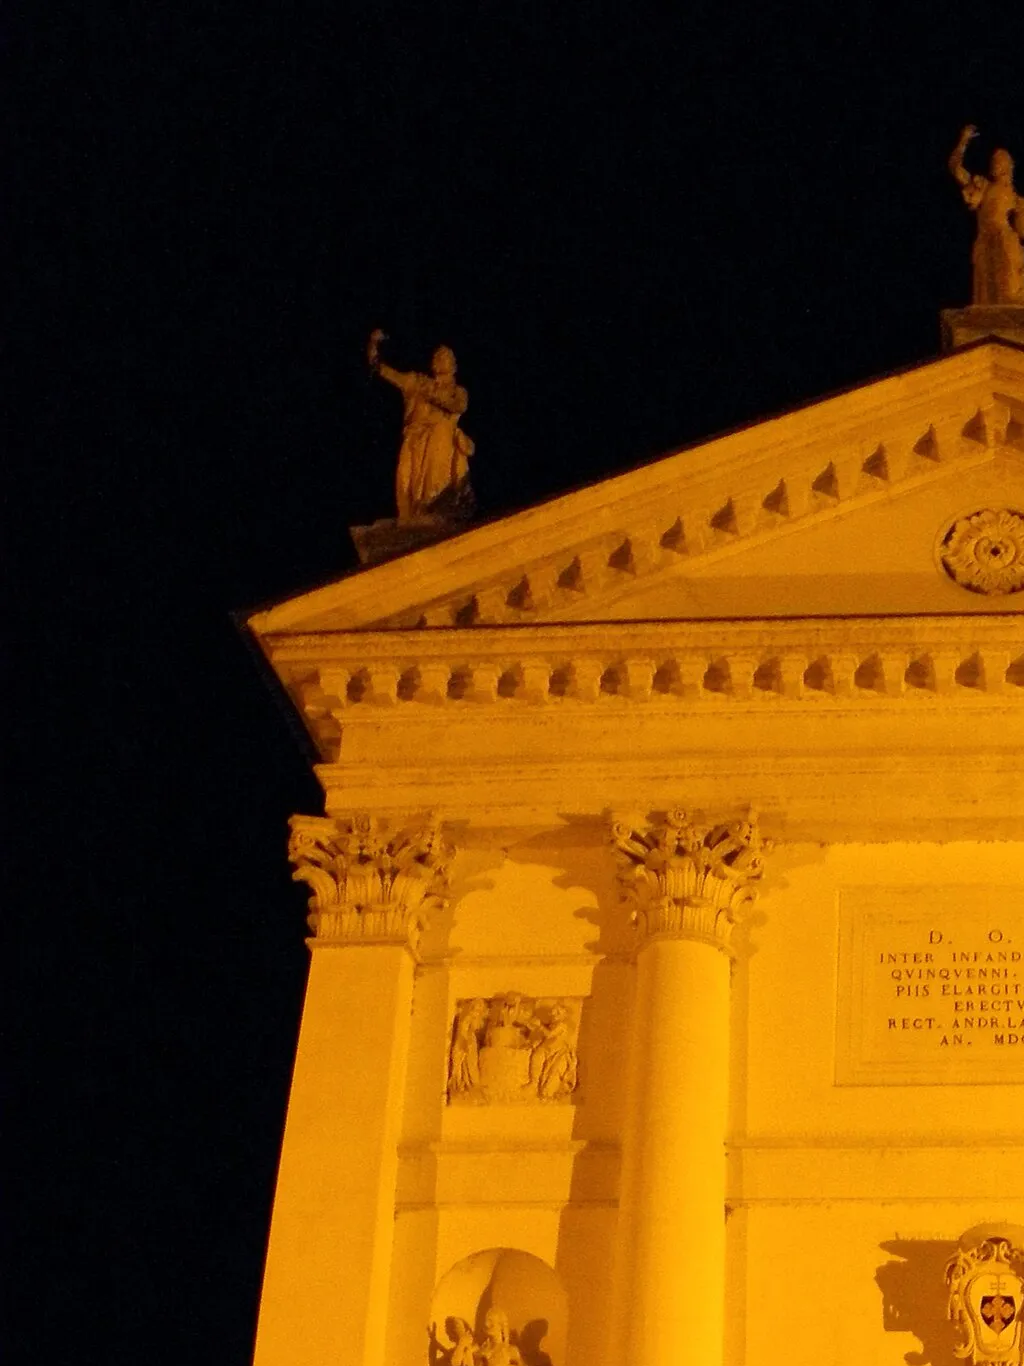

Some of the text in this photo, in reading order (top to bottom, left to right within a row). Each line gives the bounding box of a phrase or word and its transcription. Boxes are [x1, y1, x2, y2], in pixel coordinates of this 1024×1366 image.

[928, 928, 953, 945] D.
[987, 928, 1013, 944] O.
[879, 952, 935, 965] INTER
[887, 1016, 944, 1030] RECT.
[938, 1033, 973, 1047] AN.
